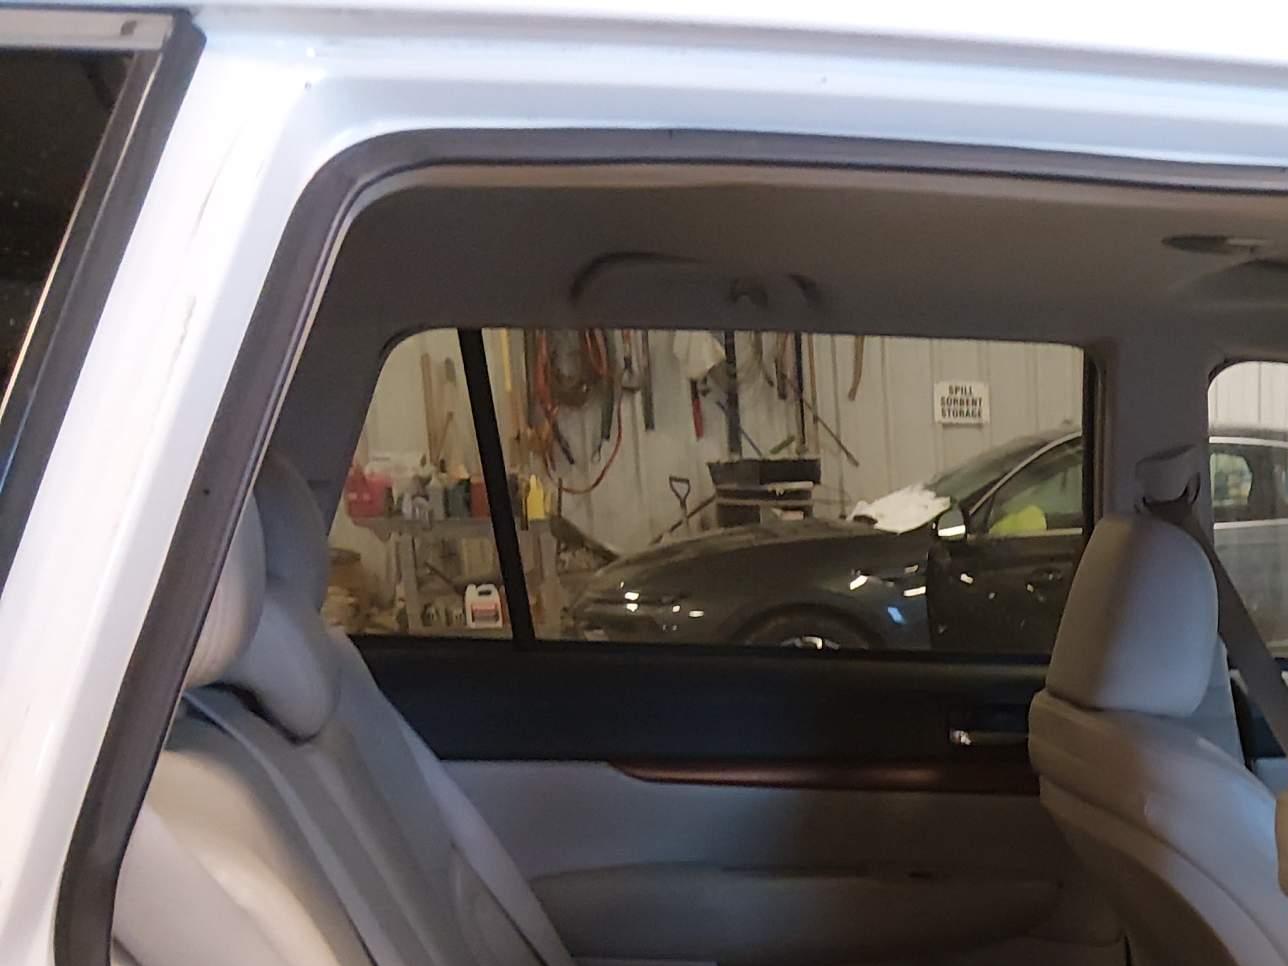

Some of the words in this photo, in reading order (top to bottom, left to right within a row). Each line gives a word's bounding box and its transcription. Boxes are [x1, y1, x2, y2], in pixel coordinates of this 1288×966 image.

[948, 385, 974, 395] SPILL
[940, 396, 983, 407] SORBENT
[940, 408, 983, 418] STORAGE
